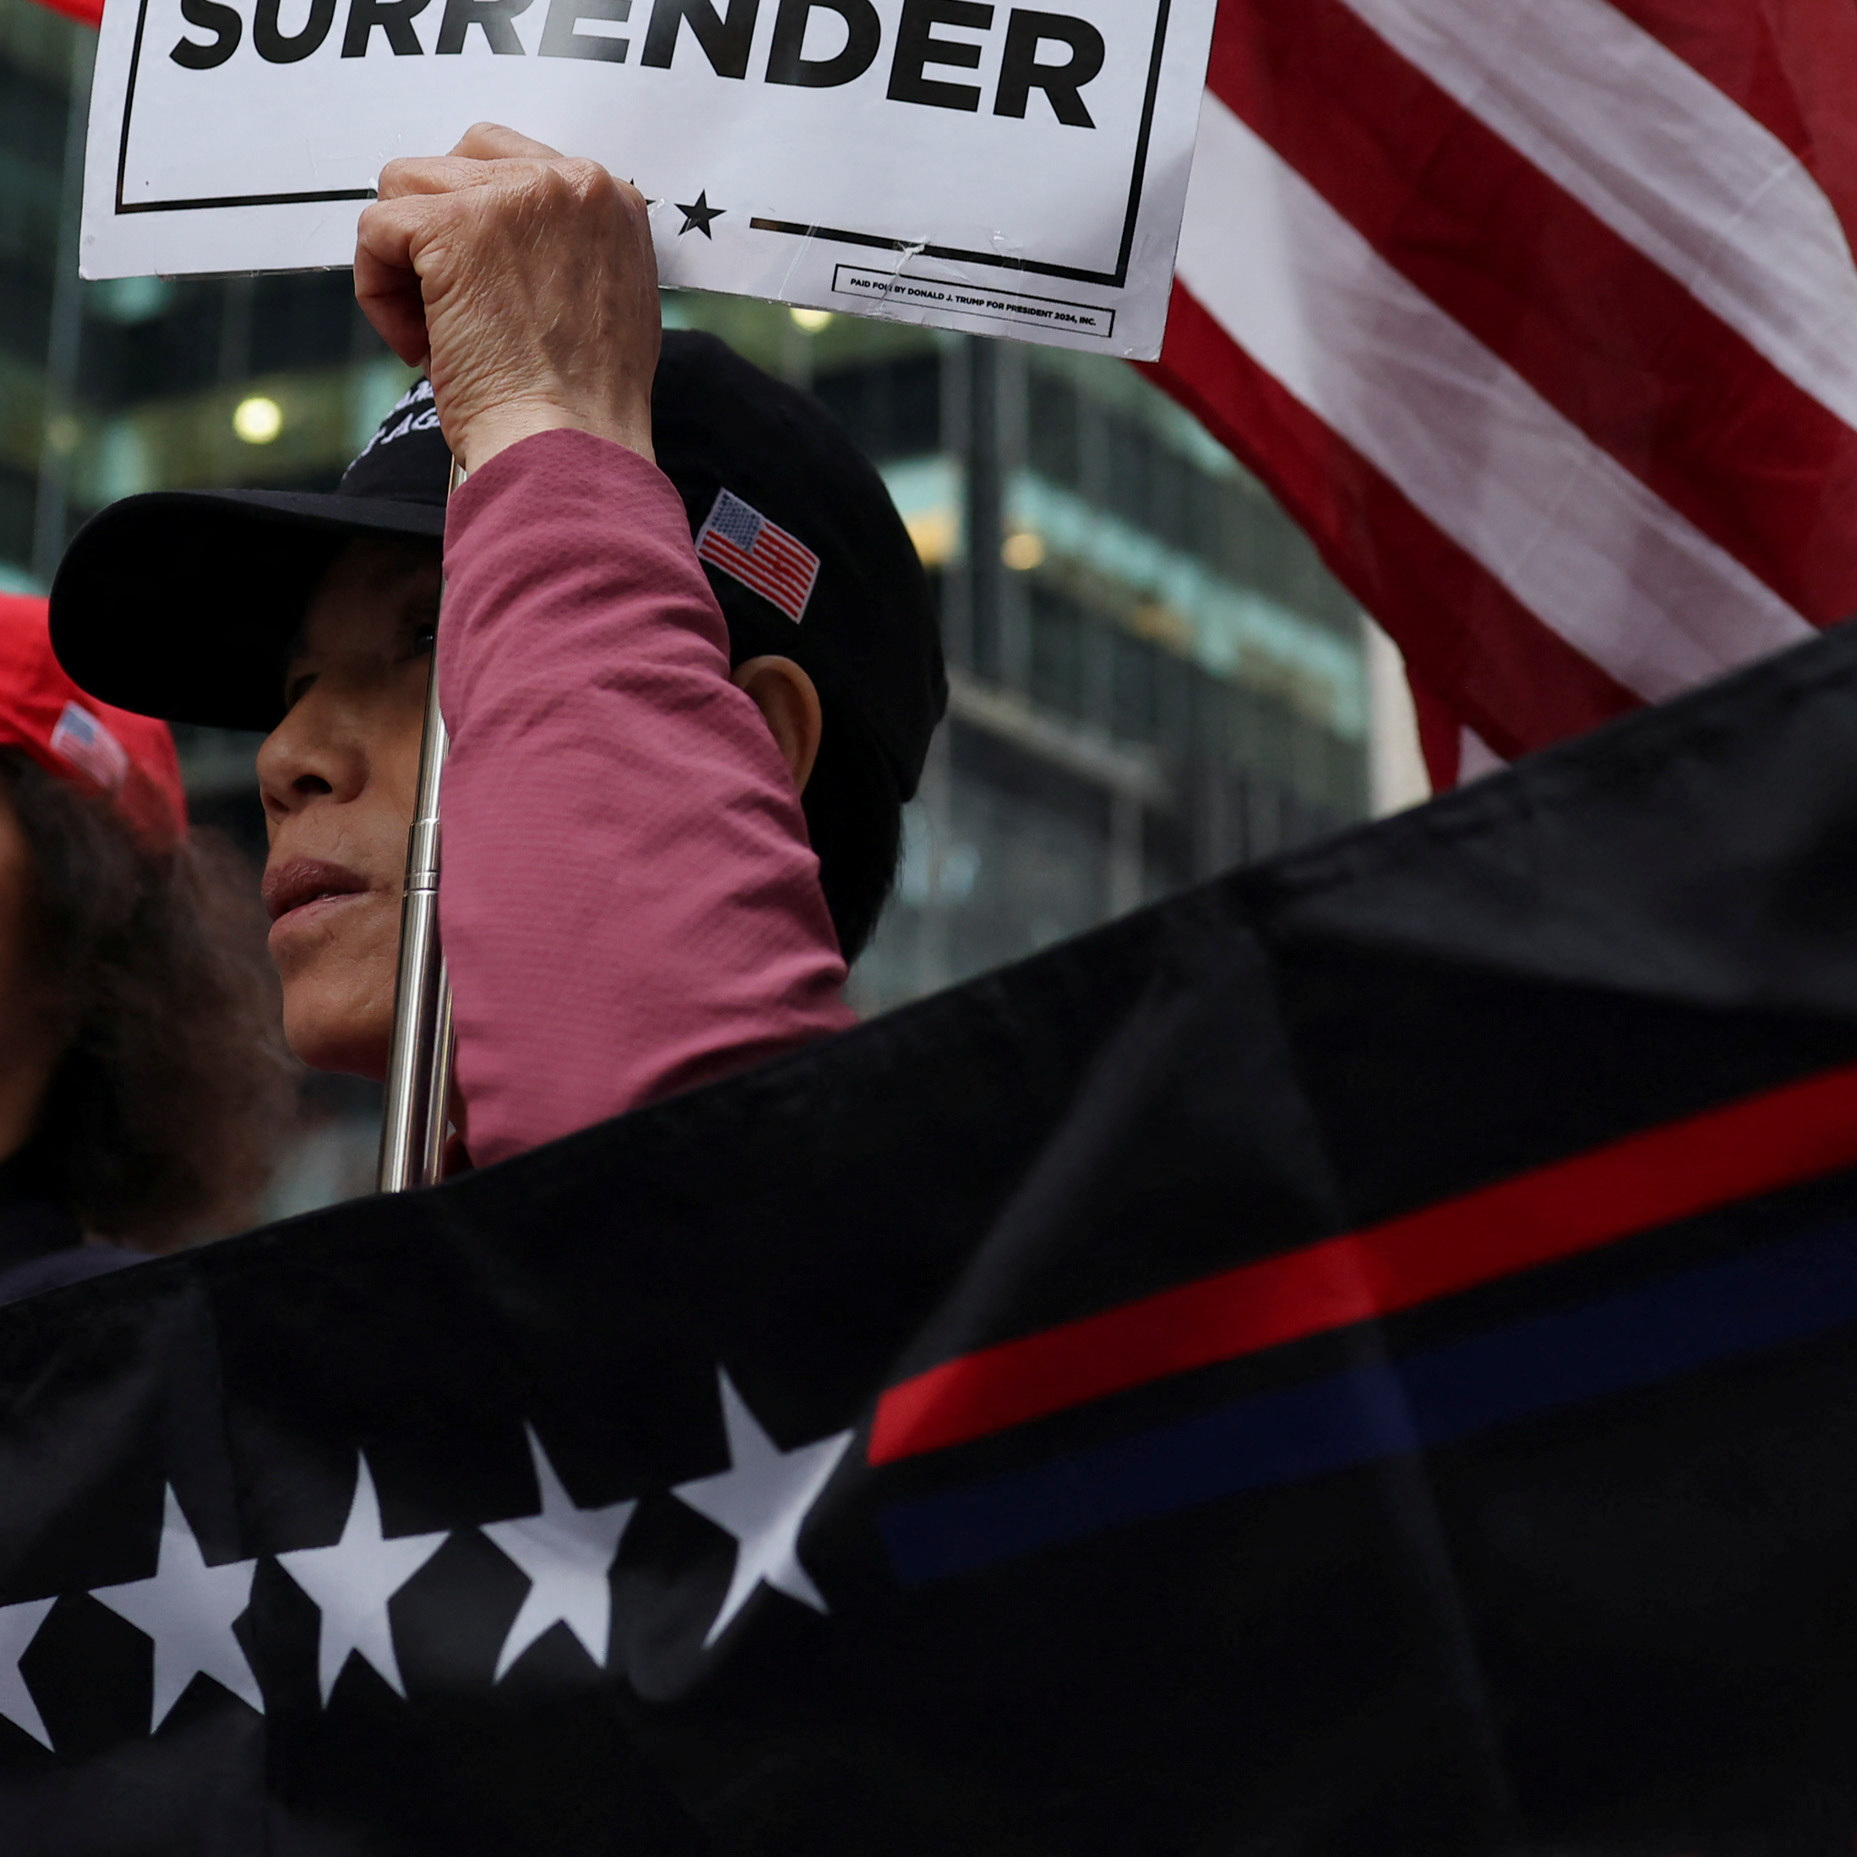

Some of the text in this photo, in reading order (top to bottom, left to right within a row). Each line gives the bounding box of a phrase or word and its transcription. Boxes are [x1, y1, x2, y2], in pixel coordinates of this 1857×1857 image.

[850, 278, 871, 288] PAID
[894, 285, 906, 294] BY
[907, 288, 945, 301] DONALD
[946, 294, 953, 302] J.
[955, 295, 985, 306] TRUMP
[986, 300, 1005, 310] FOR
[1006, 304, 1053, 319] PRESIDENT
[1054, 312, 1078, 324] 2024,
[1079, 316, 1097, 326] INC.
